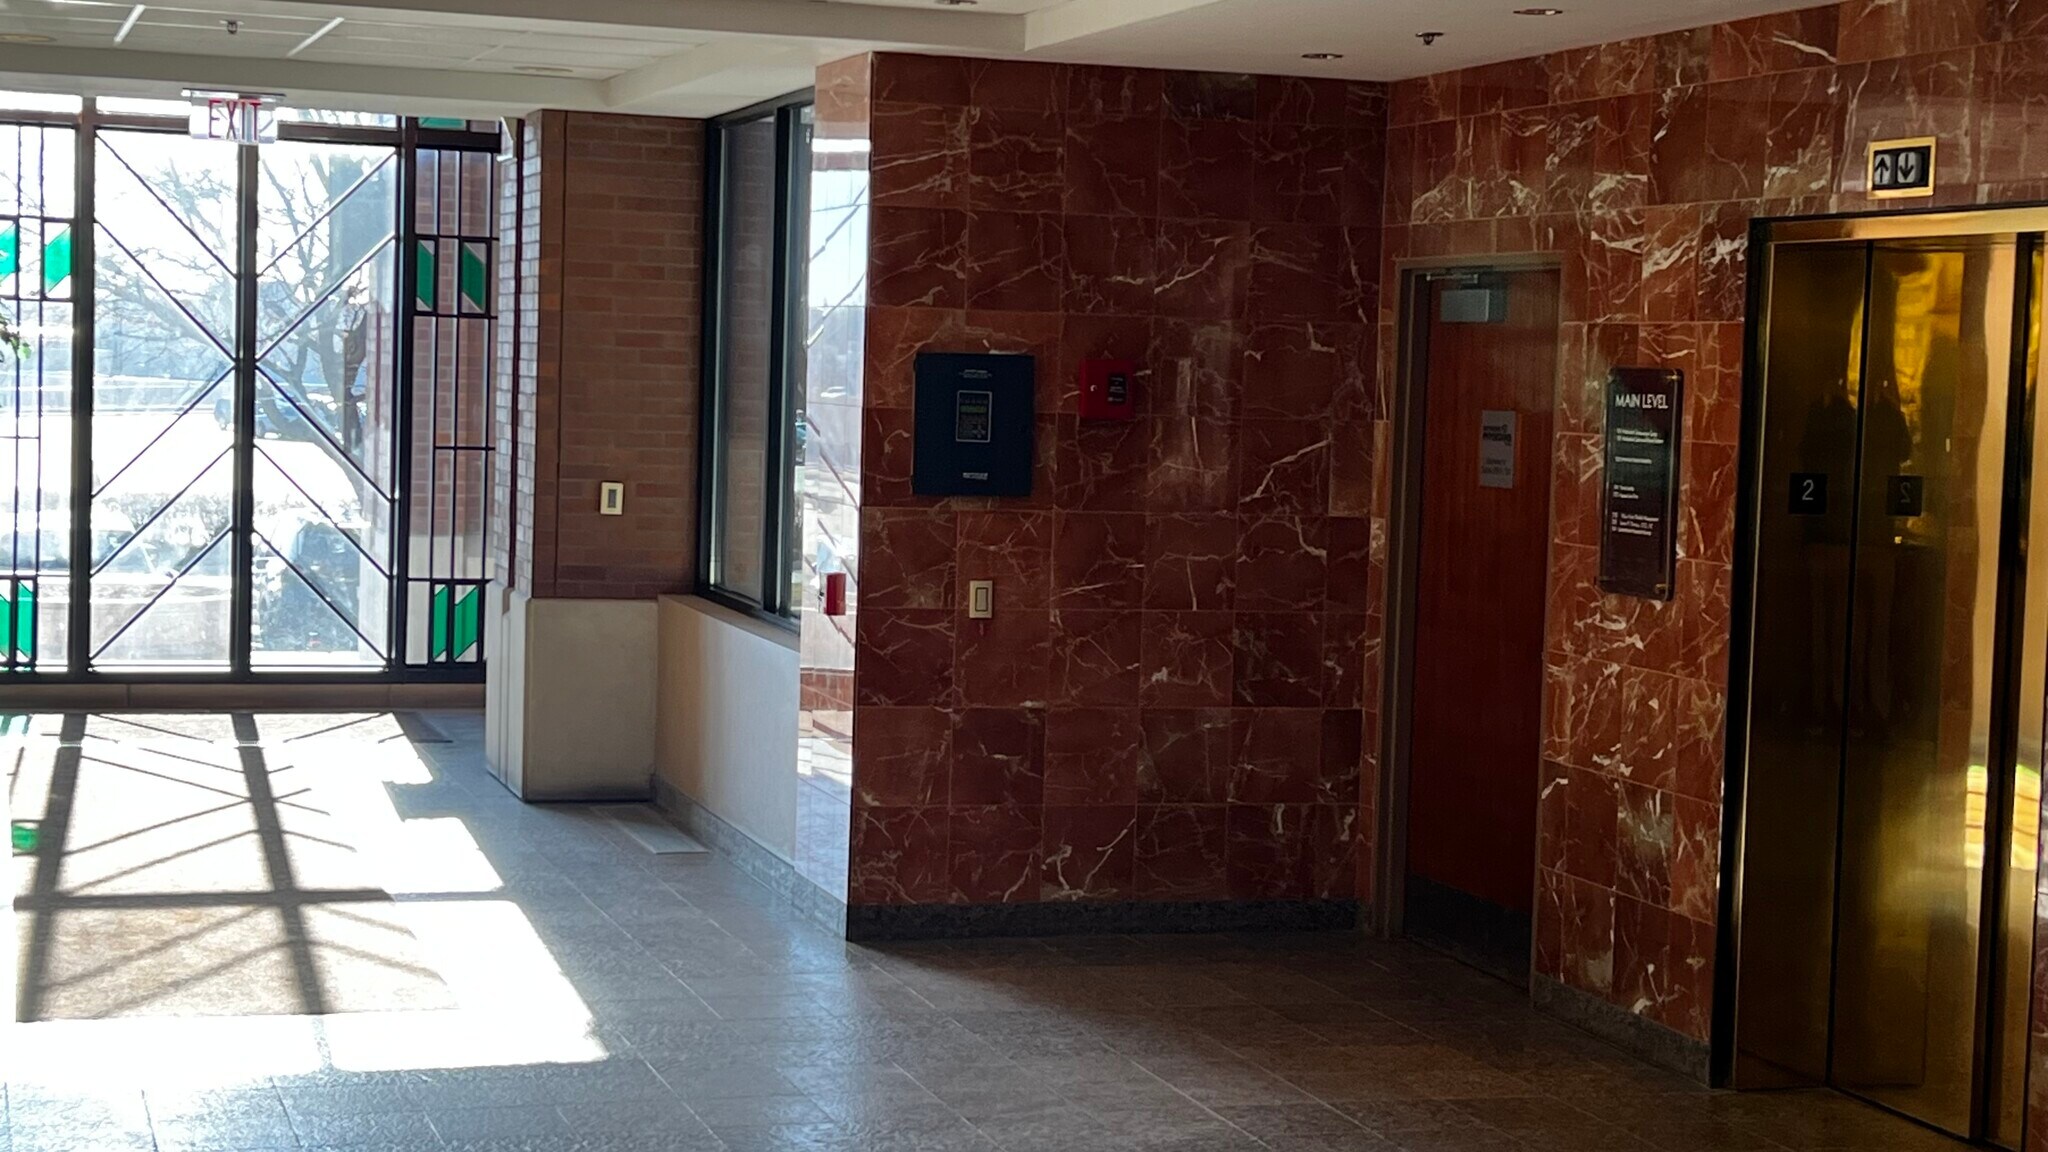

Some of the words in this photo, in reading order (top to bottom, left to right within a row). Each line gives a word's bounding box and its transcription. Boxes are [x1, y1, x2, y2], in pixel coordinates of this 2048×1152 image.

[208, 99, 262, 140] EXIT
[1615, 394, 1640, 408] MAIN
[1642, 394, 1668, 409] LEVEL
[1802, 479, 1814, 501] 2
